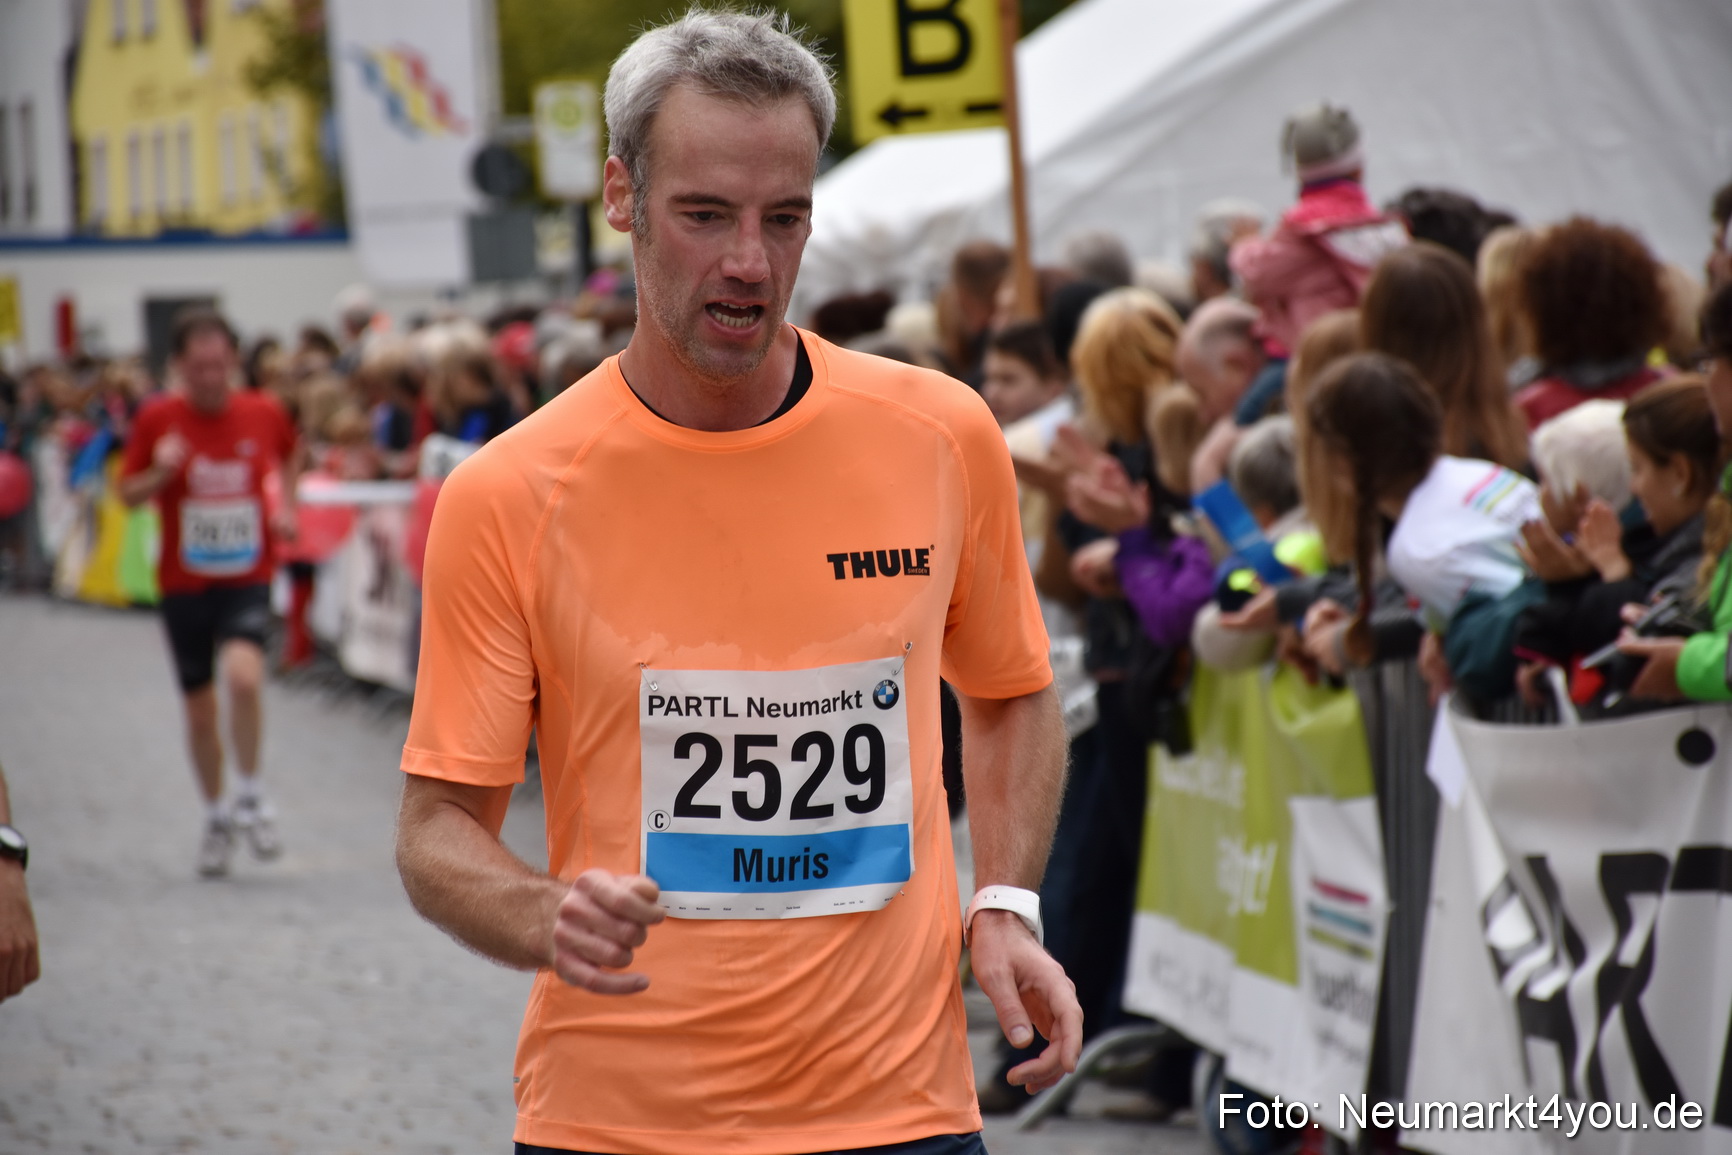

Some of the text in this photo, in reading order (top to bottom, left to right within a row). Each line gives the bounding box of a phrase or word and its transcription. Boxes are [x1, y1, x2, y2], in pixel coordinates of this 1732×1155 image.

[896, 0, 972, 76] B
[826, 548, 930, 580] THULE
[648, 689, 863, 718] PARTL Neumarkt
[673, 723, 886, 822] 2529
[733, 847, 829, 883] Muris
